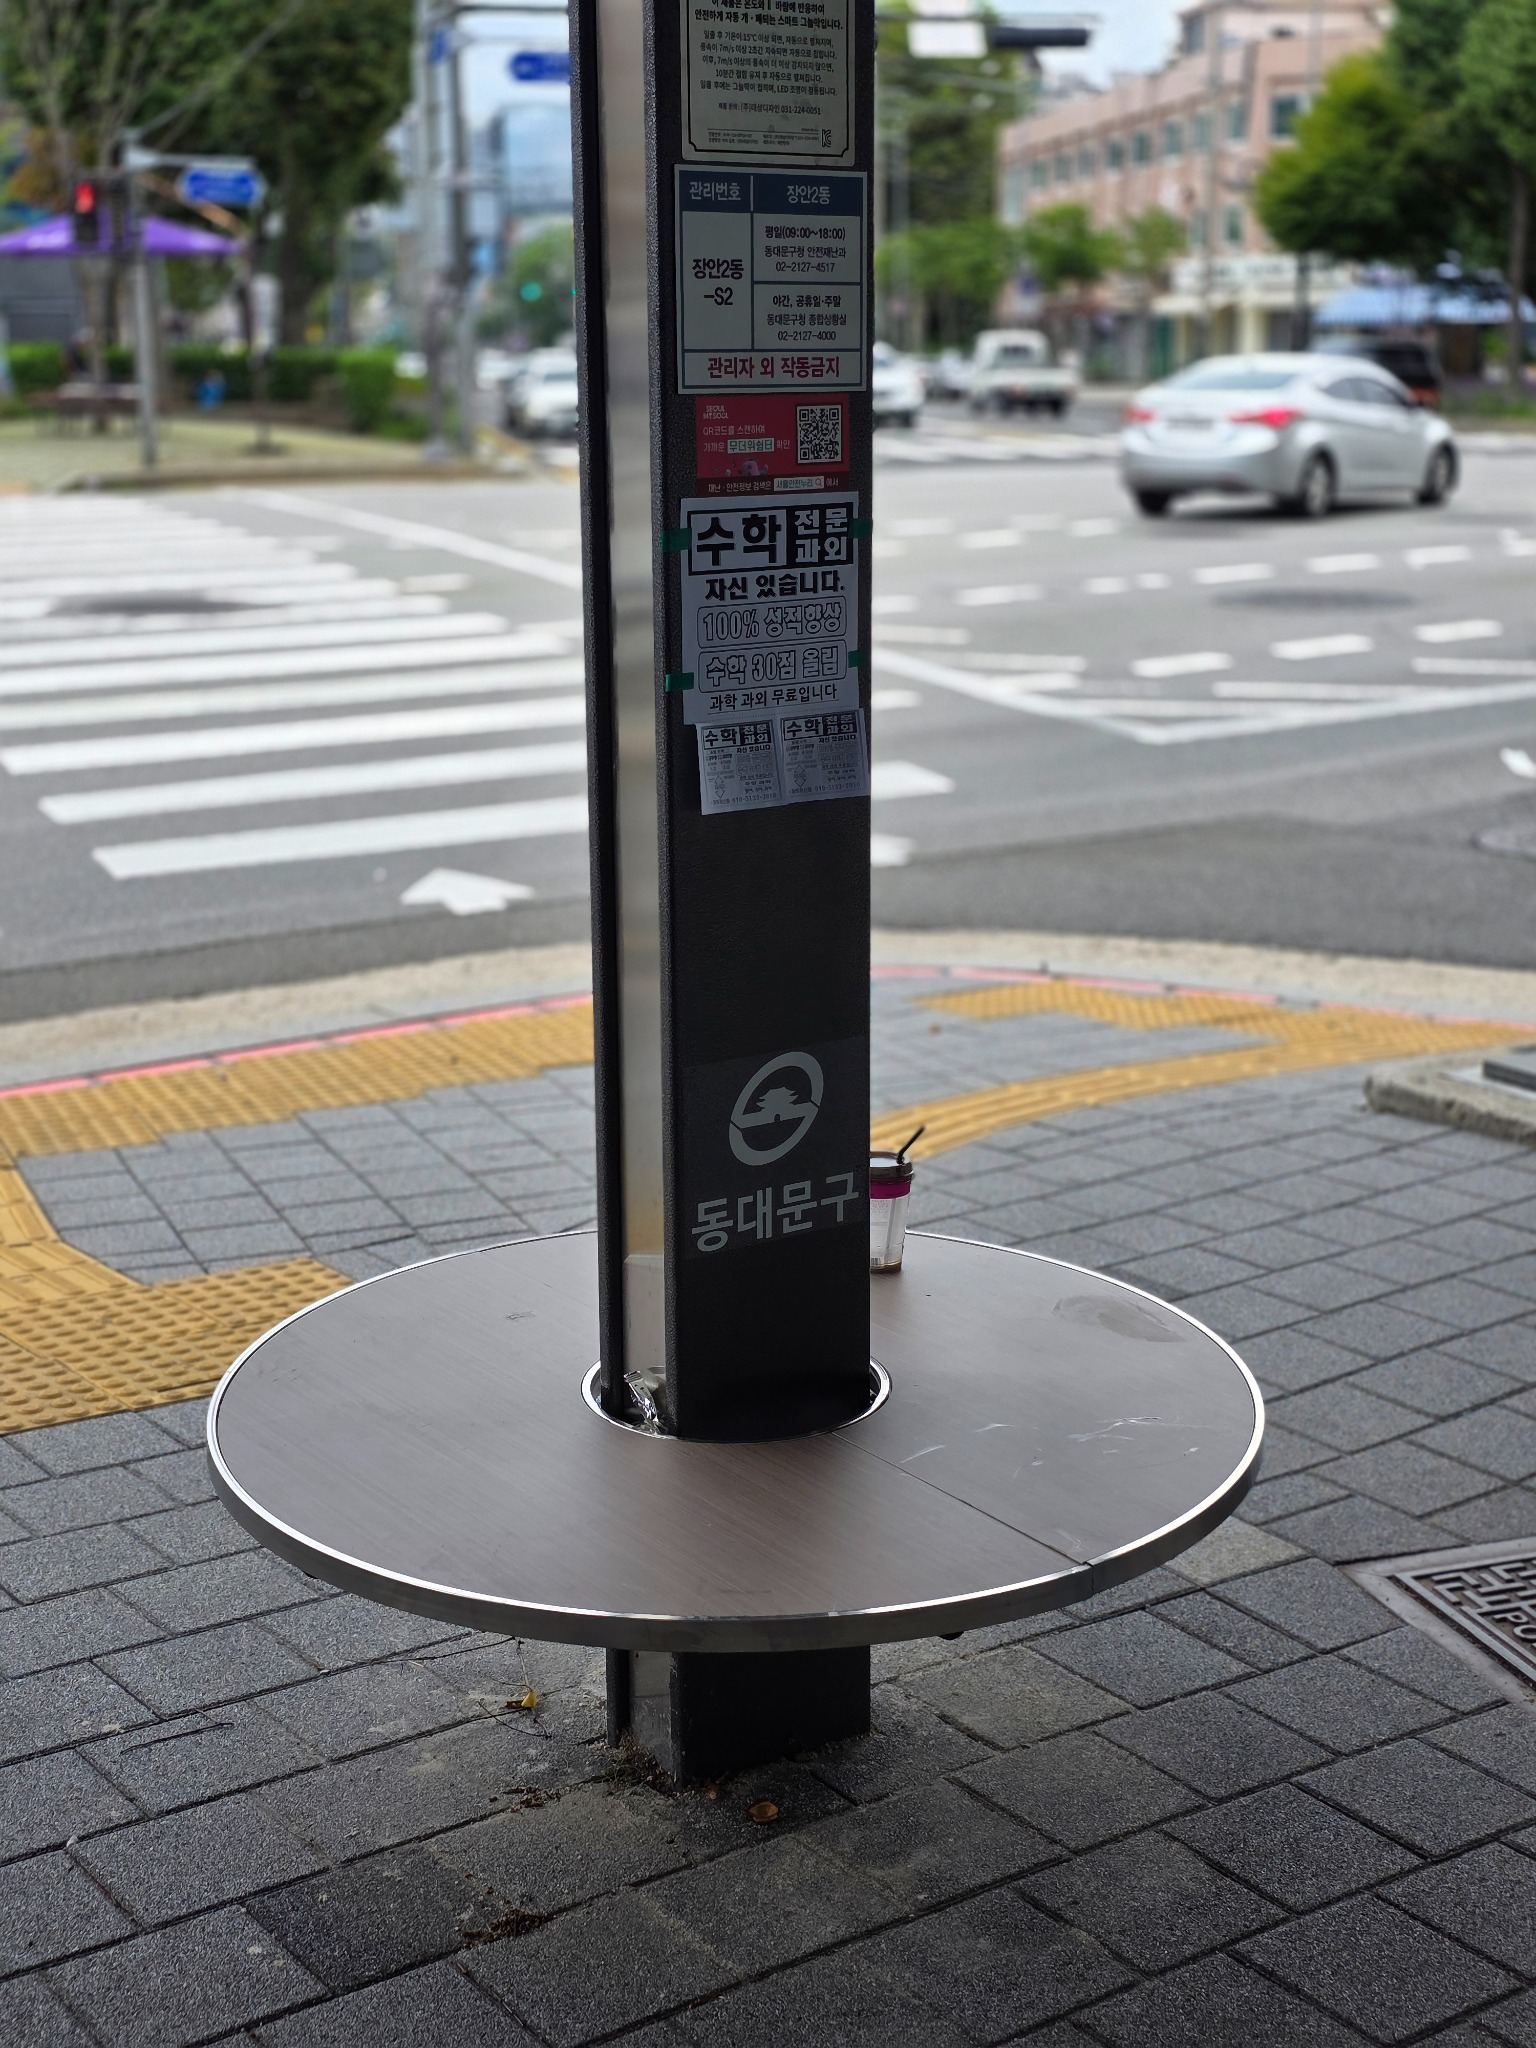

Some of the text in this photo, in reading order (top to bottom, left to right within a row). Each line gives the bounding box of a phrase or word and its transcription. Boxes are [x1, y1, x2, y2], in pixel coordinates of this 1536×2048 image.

[776, 0, 796, 13] 바람에
[798, 2, 825, 15] 반응하여
[695, 8, 724, 22] 안전하게
[725, 11, 740, 23] 자동
[778, 15, 798, 26] 스마트
[800, 16, 843, 30] 그늘막입니다.
[717, 30, 722, 40] 후
[724, 31, 742, 42] 기온이
[771, 34, 785, 45] 되면,
[786, 35, 808, 46] 자동으로
[790, 48, 812, 58] 자동으로
[778, 59, 790, 70] 이상
[791, 60, 814, 70] 감지되지
[762, 71, 768, 81] 후
[770, 71, 792, 82] 자동으로
[714, 80, 731, 91] 후에는
[777, 84, 789, 94] LED
[689, 182, 742, 201] 관리번호
[787, 185, 831, 205] 장안2동
[764, 226, 846, 241] 평일(09:00~18:00)
[764, 245, 846, 259] 동대문구청 안전재난과
[692, 258, 744, 280] 장안2동
[776, 262, 836, 273] 02-2127-4517
[772, 294, 793, 308] 야간,
[766, 314, 847, 326] 동대문구청 종합상황실
[778, 330, 836, 342] 02-2127-4000
[708, 356, 840, 379] 관리자 외 작동금지
[703, 425, 766, 436] QR코드를 스캔하여
[704, 440, 790, 452] 가까운 무더위쉼터 확인
[753, 481, 772, 491] 검색은
[776, 479, 813, 490] 서울안전누리
[826, 478, 839, 487] 에서
[794, 508, 848, 534] 전문
[697, 514, 782, 566] 수학
[795, 536, 848, 563] 과외
[705, 570, 846, 601] 자신 있습니다.
[703, 602, 842, 641] 100% 성적향상
[706, 646, 839, 687] 수학 30점 올림
[710, 684, 838, 711] 과학 과외 무료입니다
[786, 719, 821, 738] 수학
[705, 728, 738, 747] 수학
[692, 1172, 859, 1252] 동대문구
